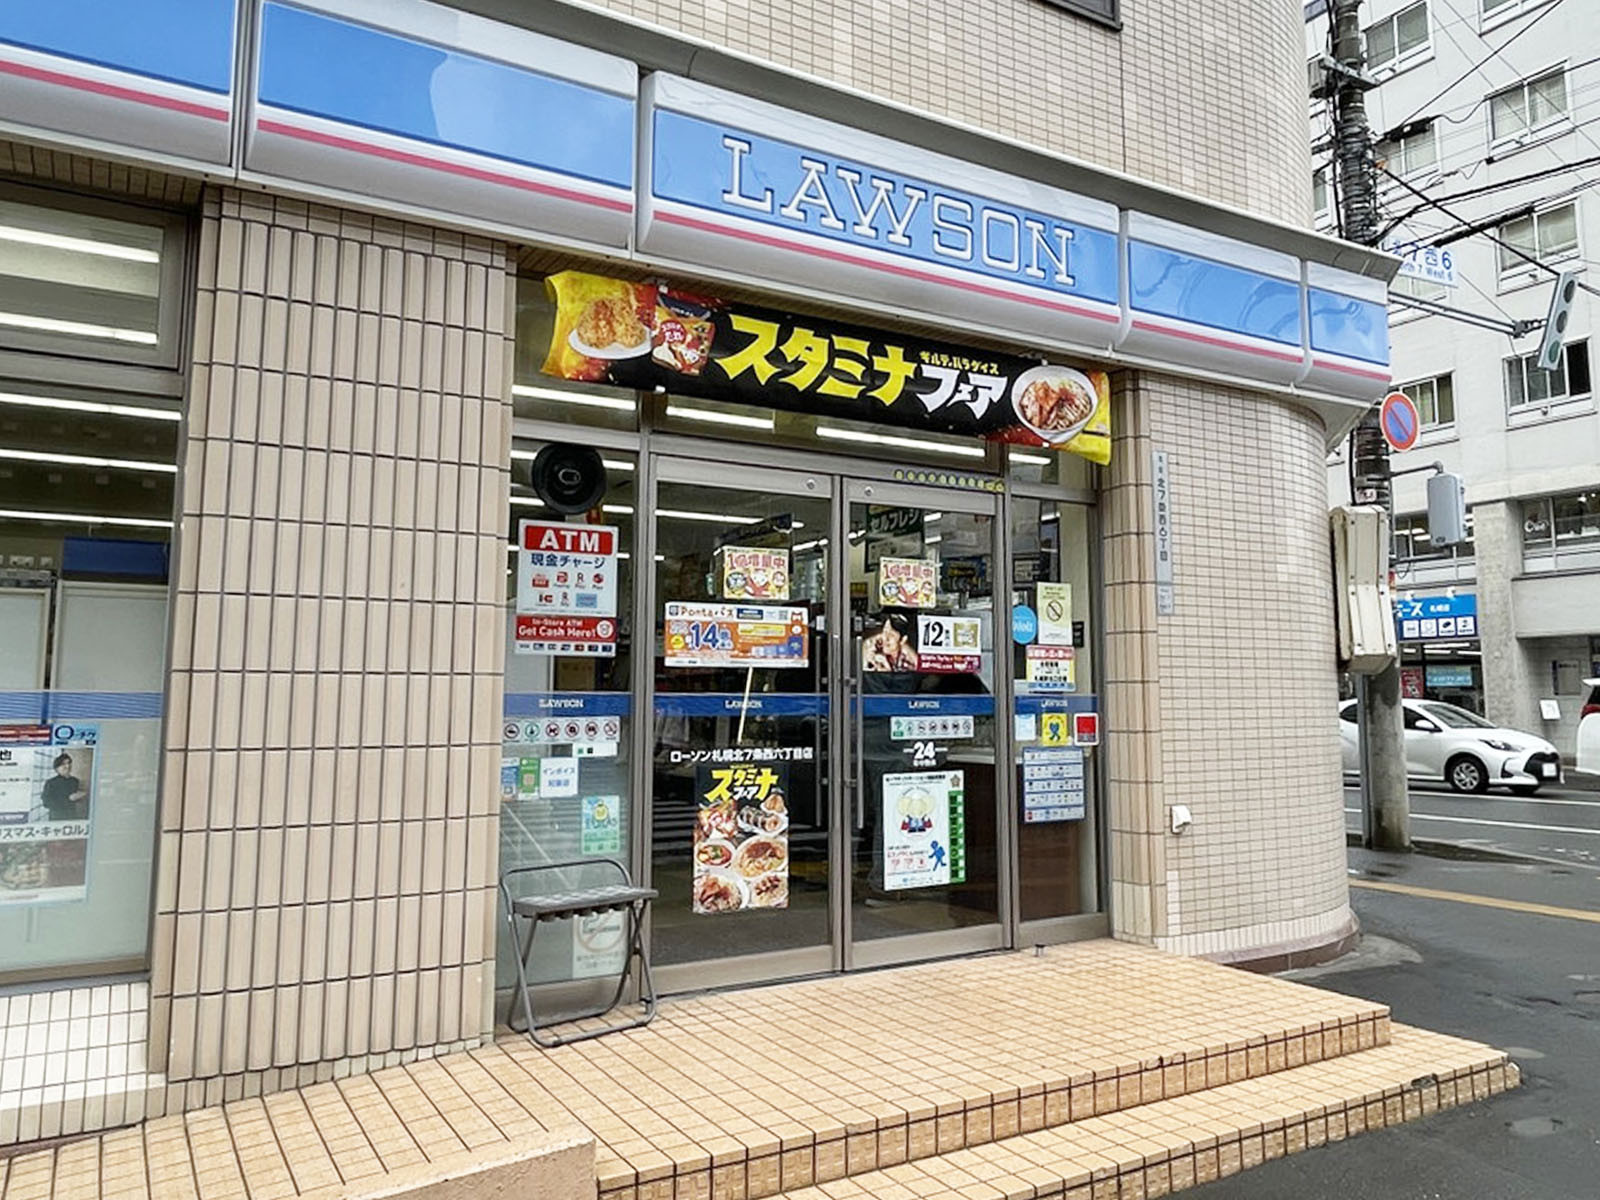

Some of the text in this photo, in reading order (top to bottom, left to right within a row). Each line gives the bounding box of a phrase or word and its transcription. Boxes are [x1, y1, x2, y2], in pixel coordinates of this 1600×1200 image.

[722, 135, 1076, 286] LAWSON
[714, 314, 918, 407] スタミナ
[915, 363, 1009, 420] フェア
[539, 528, 599, 552] ATM
[531, 553, 605, 569] 現金チャージ
[680, 606, 734, 617] Pontaパス
[518, 625, 596, 638] Get Cash Here!
[689, 622, 719, 650] 14
[923, 621, 944, 647] 12
[914, 741, 935, 759] 24
[704, 767, 779, 802] スタミナ
[0, 824, 90, 839] スマス・キャロル」
